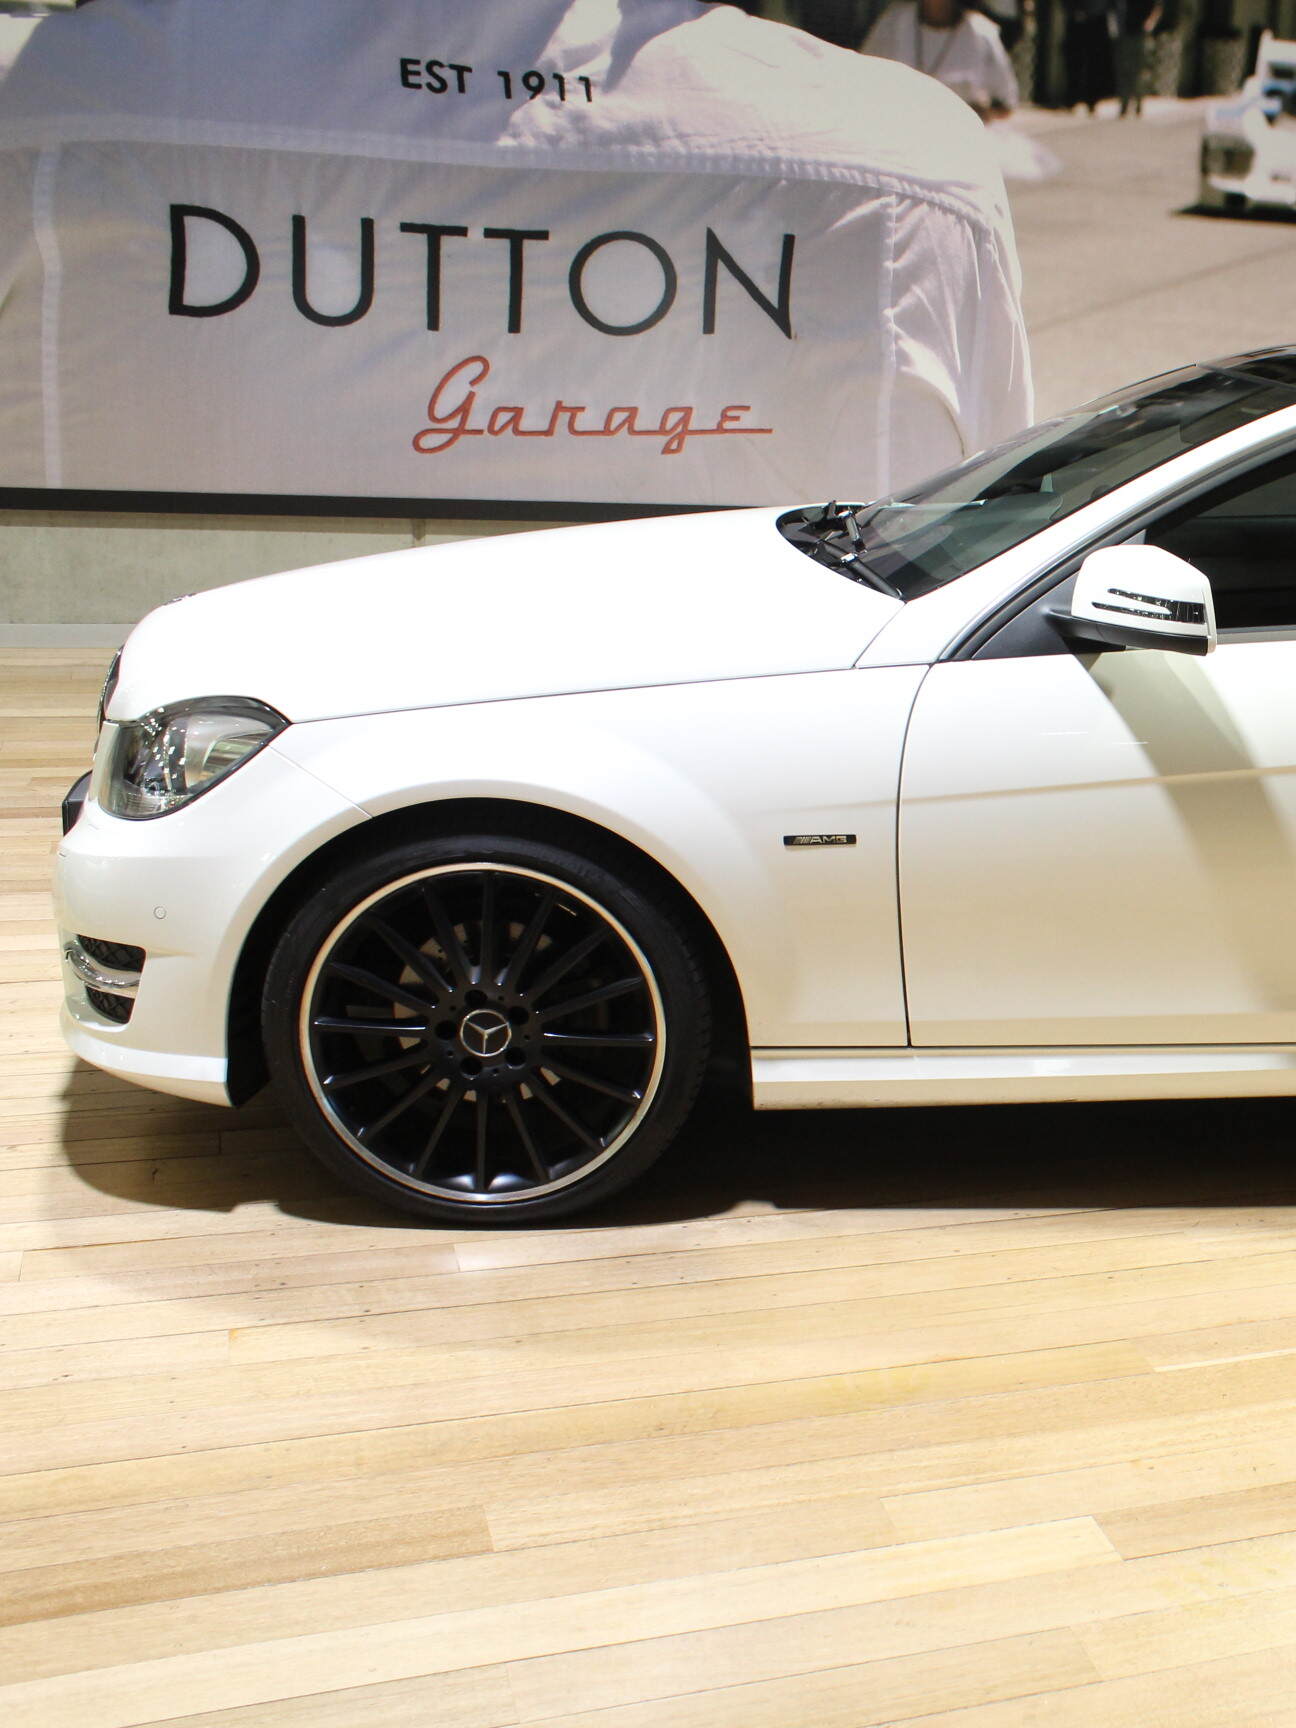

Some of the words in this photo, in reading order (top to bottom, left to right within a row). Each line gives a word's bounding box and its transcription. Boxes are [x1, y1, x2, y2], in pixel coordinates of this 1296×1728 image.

[400, 57, 473, 94] EST
[497, 70, 592, 103] 1911
[168, 203, 796, 341] DUTTON
[412, 355, 773, 455] Garage
